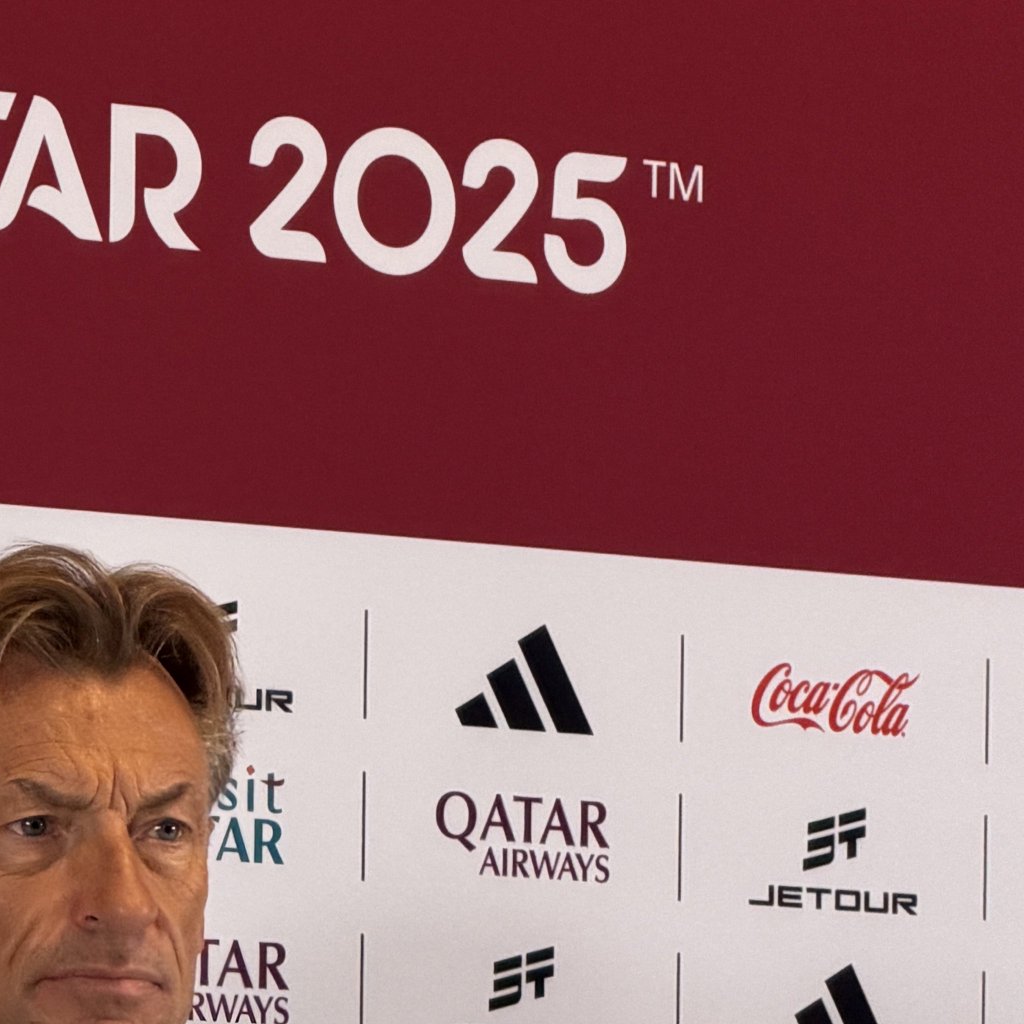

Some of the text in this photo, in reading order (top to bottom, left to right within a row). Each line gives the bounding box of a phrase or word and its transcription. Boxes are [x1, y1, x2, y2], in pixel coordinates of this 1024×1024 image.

[248, 115, 628, 295] 2025
[210, 815, 285, 865] AR
[435, 790, 610, 852] QATAR
[479, 846, 610, 884] AIRWAYS
[748, 884, 919, 917] JETOUR
